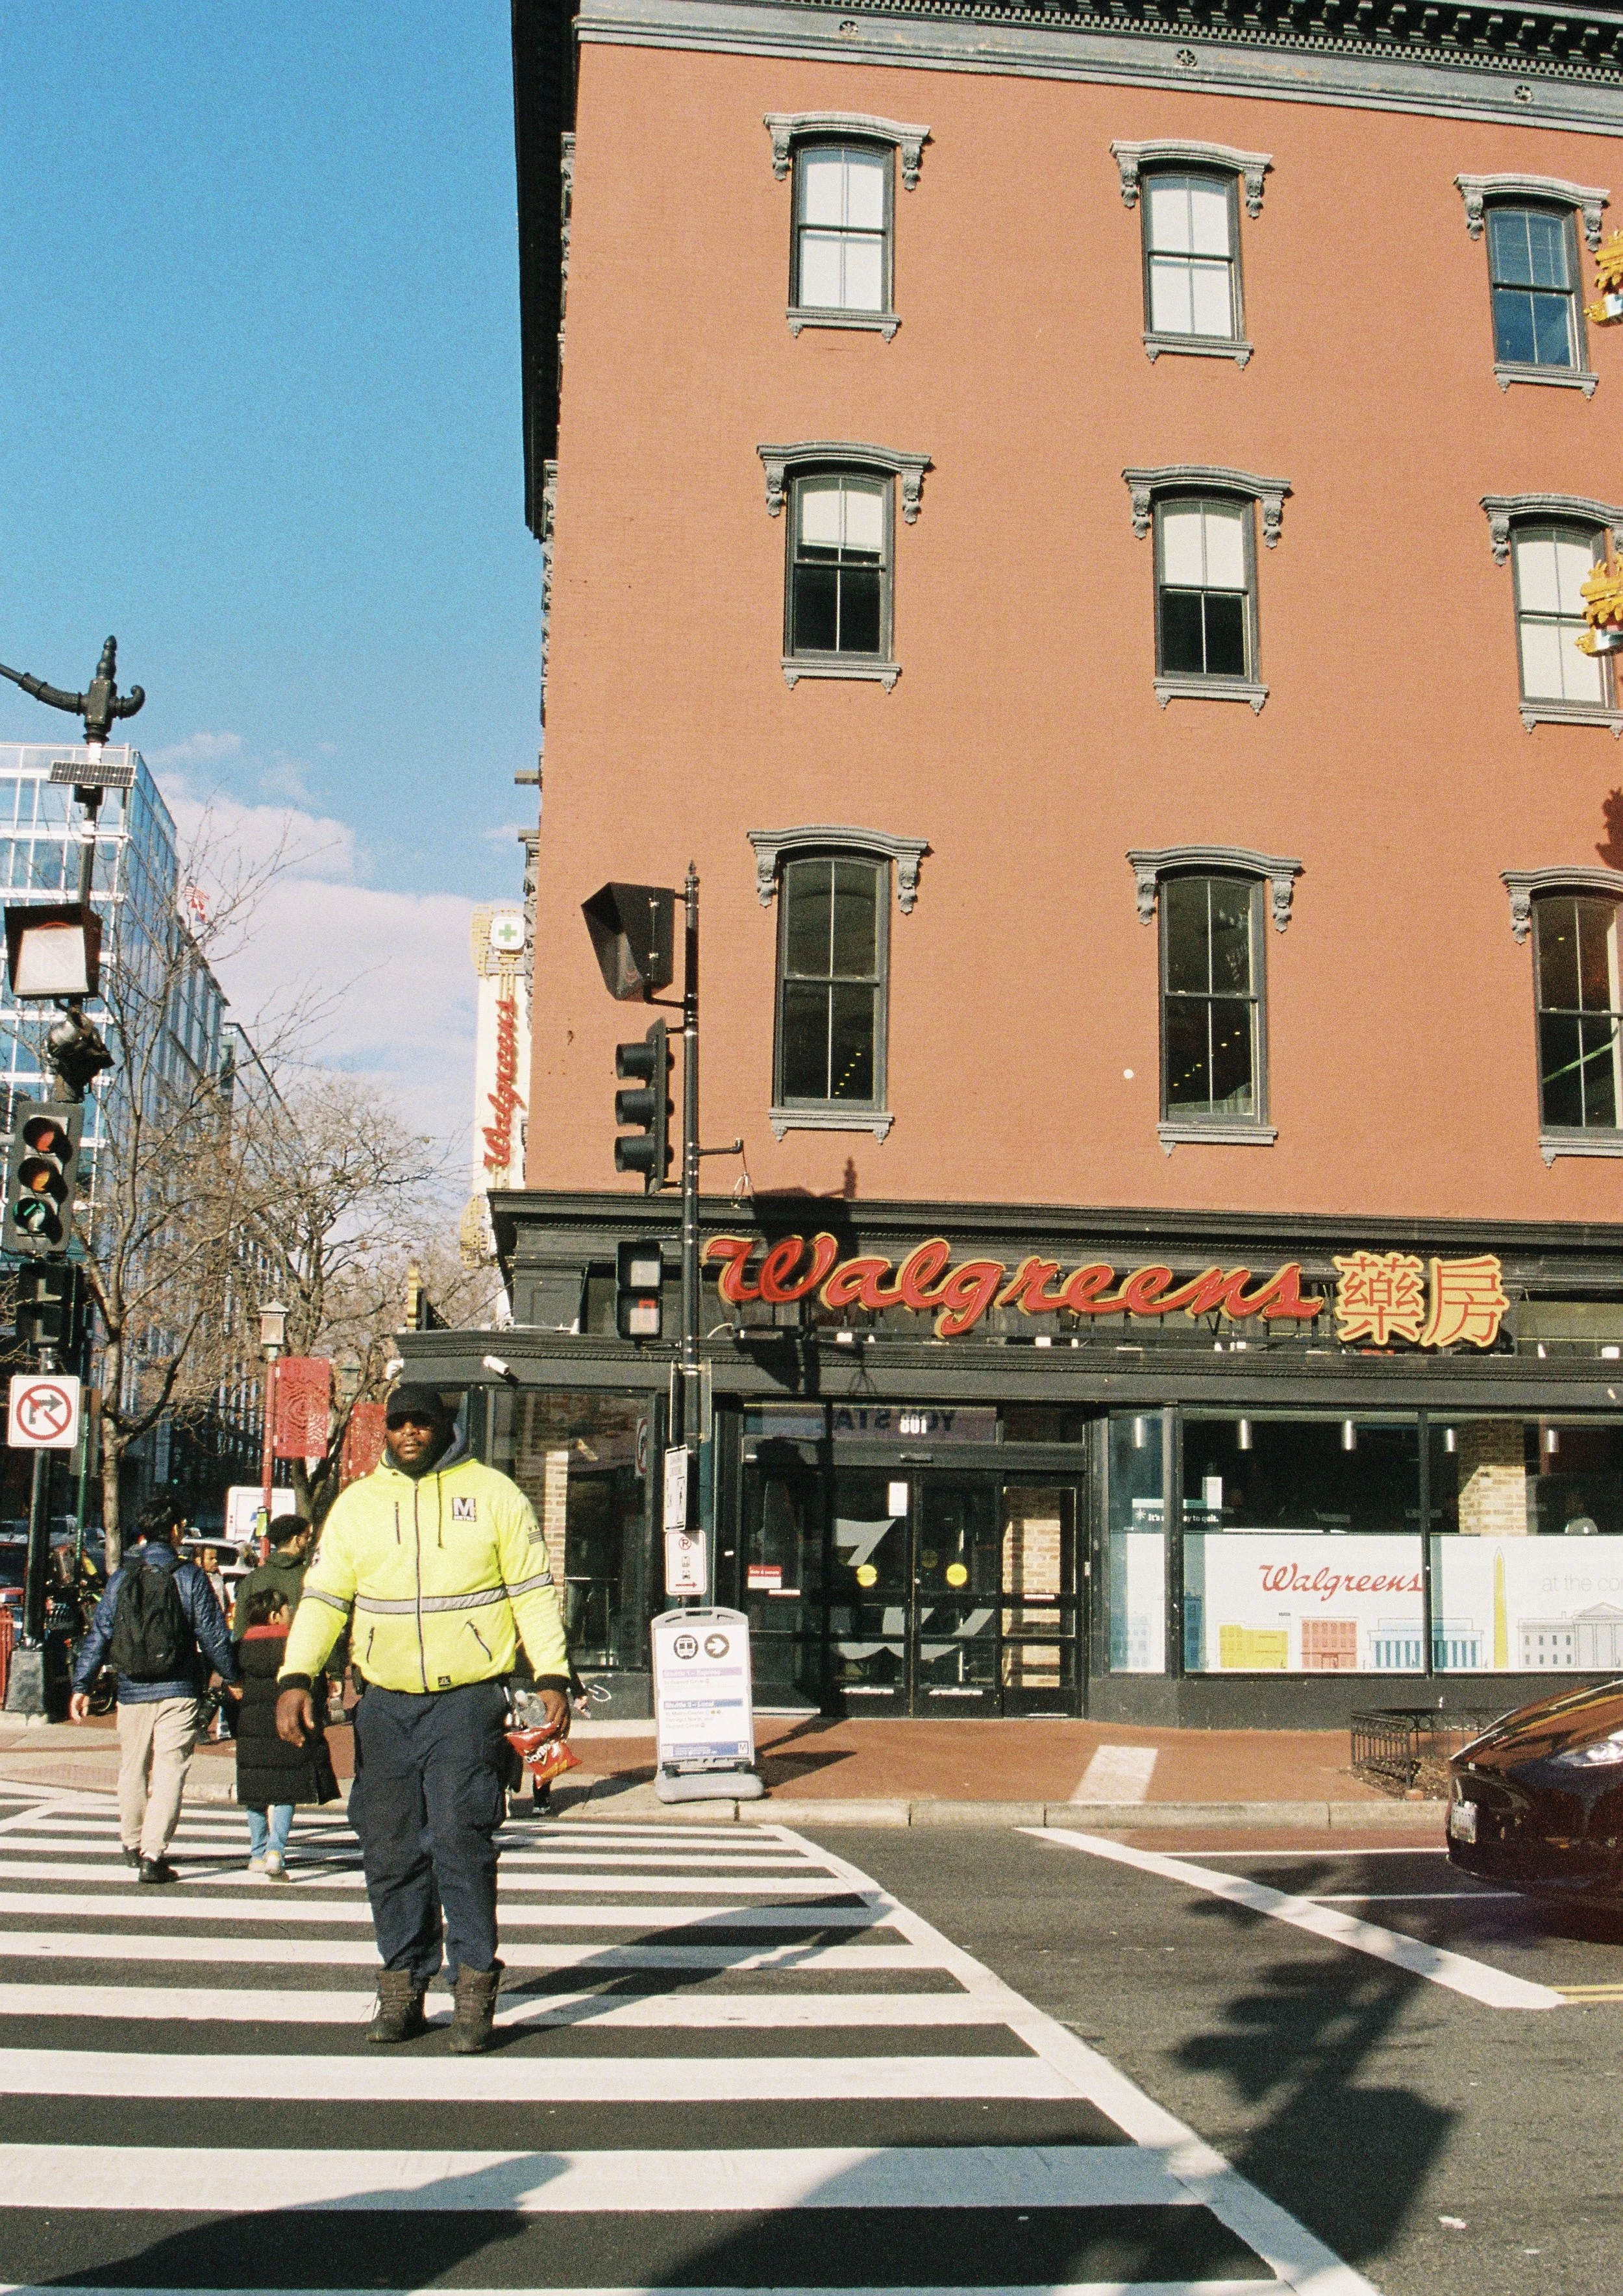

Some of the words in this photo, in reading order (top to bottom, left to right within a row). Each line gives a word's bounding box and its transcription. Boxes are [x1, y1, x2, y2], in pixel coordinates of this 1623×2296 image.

[482, 993, 527, 1168] Walgreens
[702, 1232, 1323, 1339] Walgreens
[1332, 1252, 1510, 1348] 藥房
[454, 1498, 476, 1516] M
[1259, 1563, 1425, 1601] Walgreens
[1542, 1575, 1559, 1592] at
[1564, 1574, 1592, 1592] the
